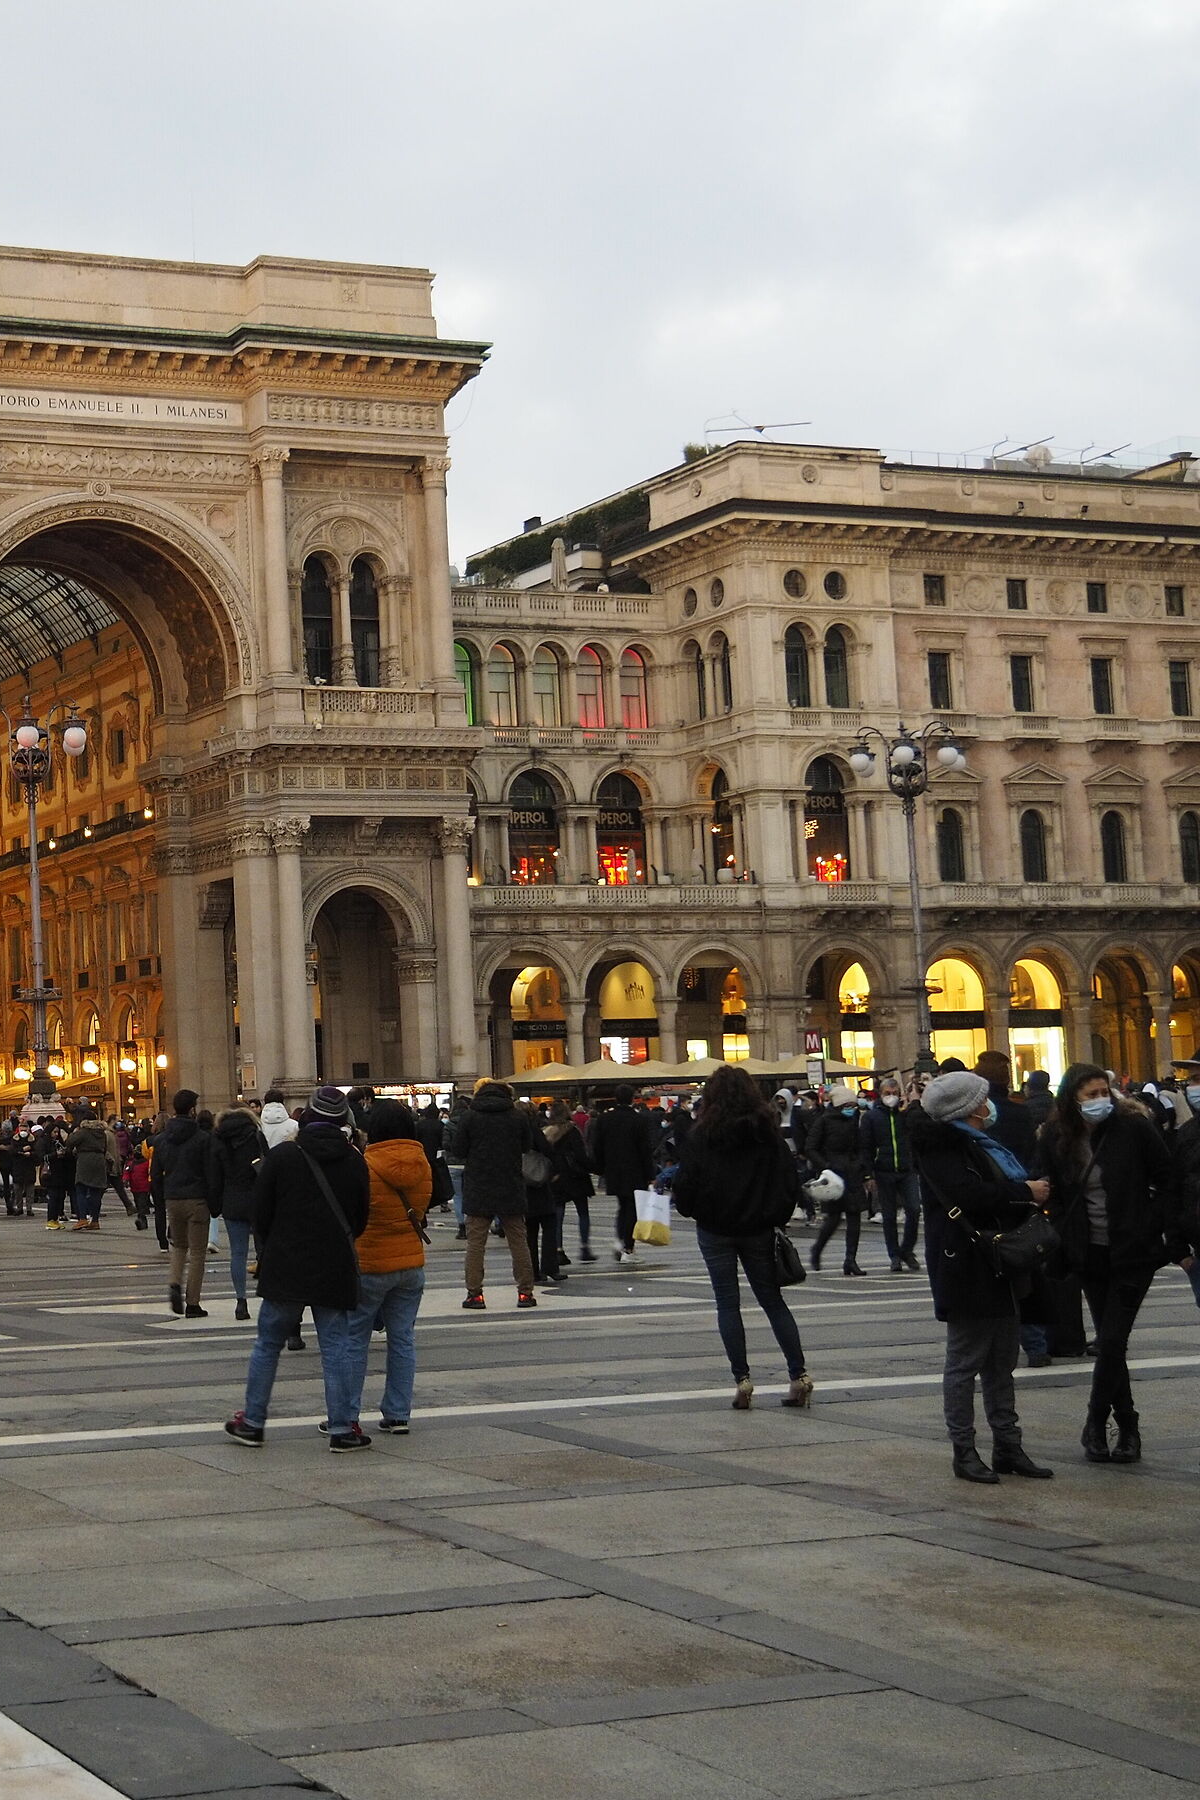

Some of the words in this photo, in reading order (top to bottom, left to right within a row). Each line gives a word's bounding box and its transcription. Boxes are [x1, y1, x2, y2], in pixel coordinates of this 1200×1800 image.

[48, 397, 124, 414] EMANUELE
[166, 405, 227, 420] MILANESI
[804, 795, 838, 809] PEROL
[806, 1033, 819, 1050] M
